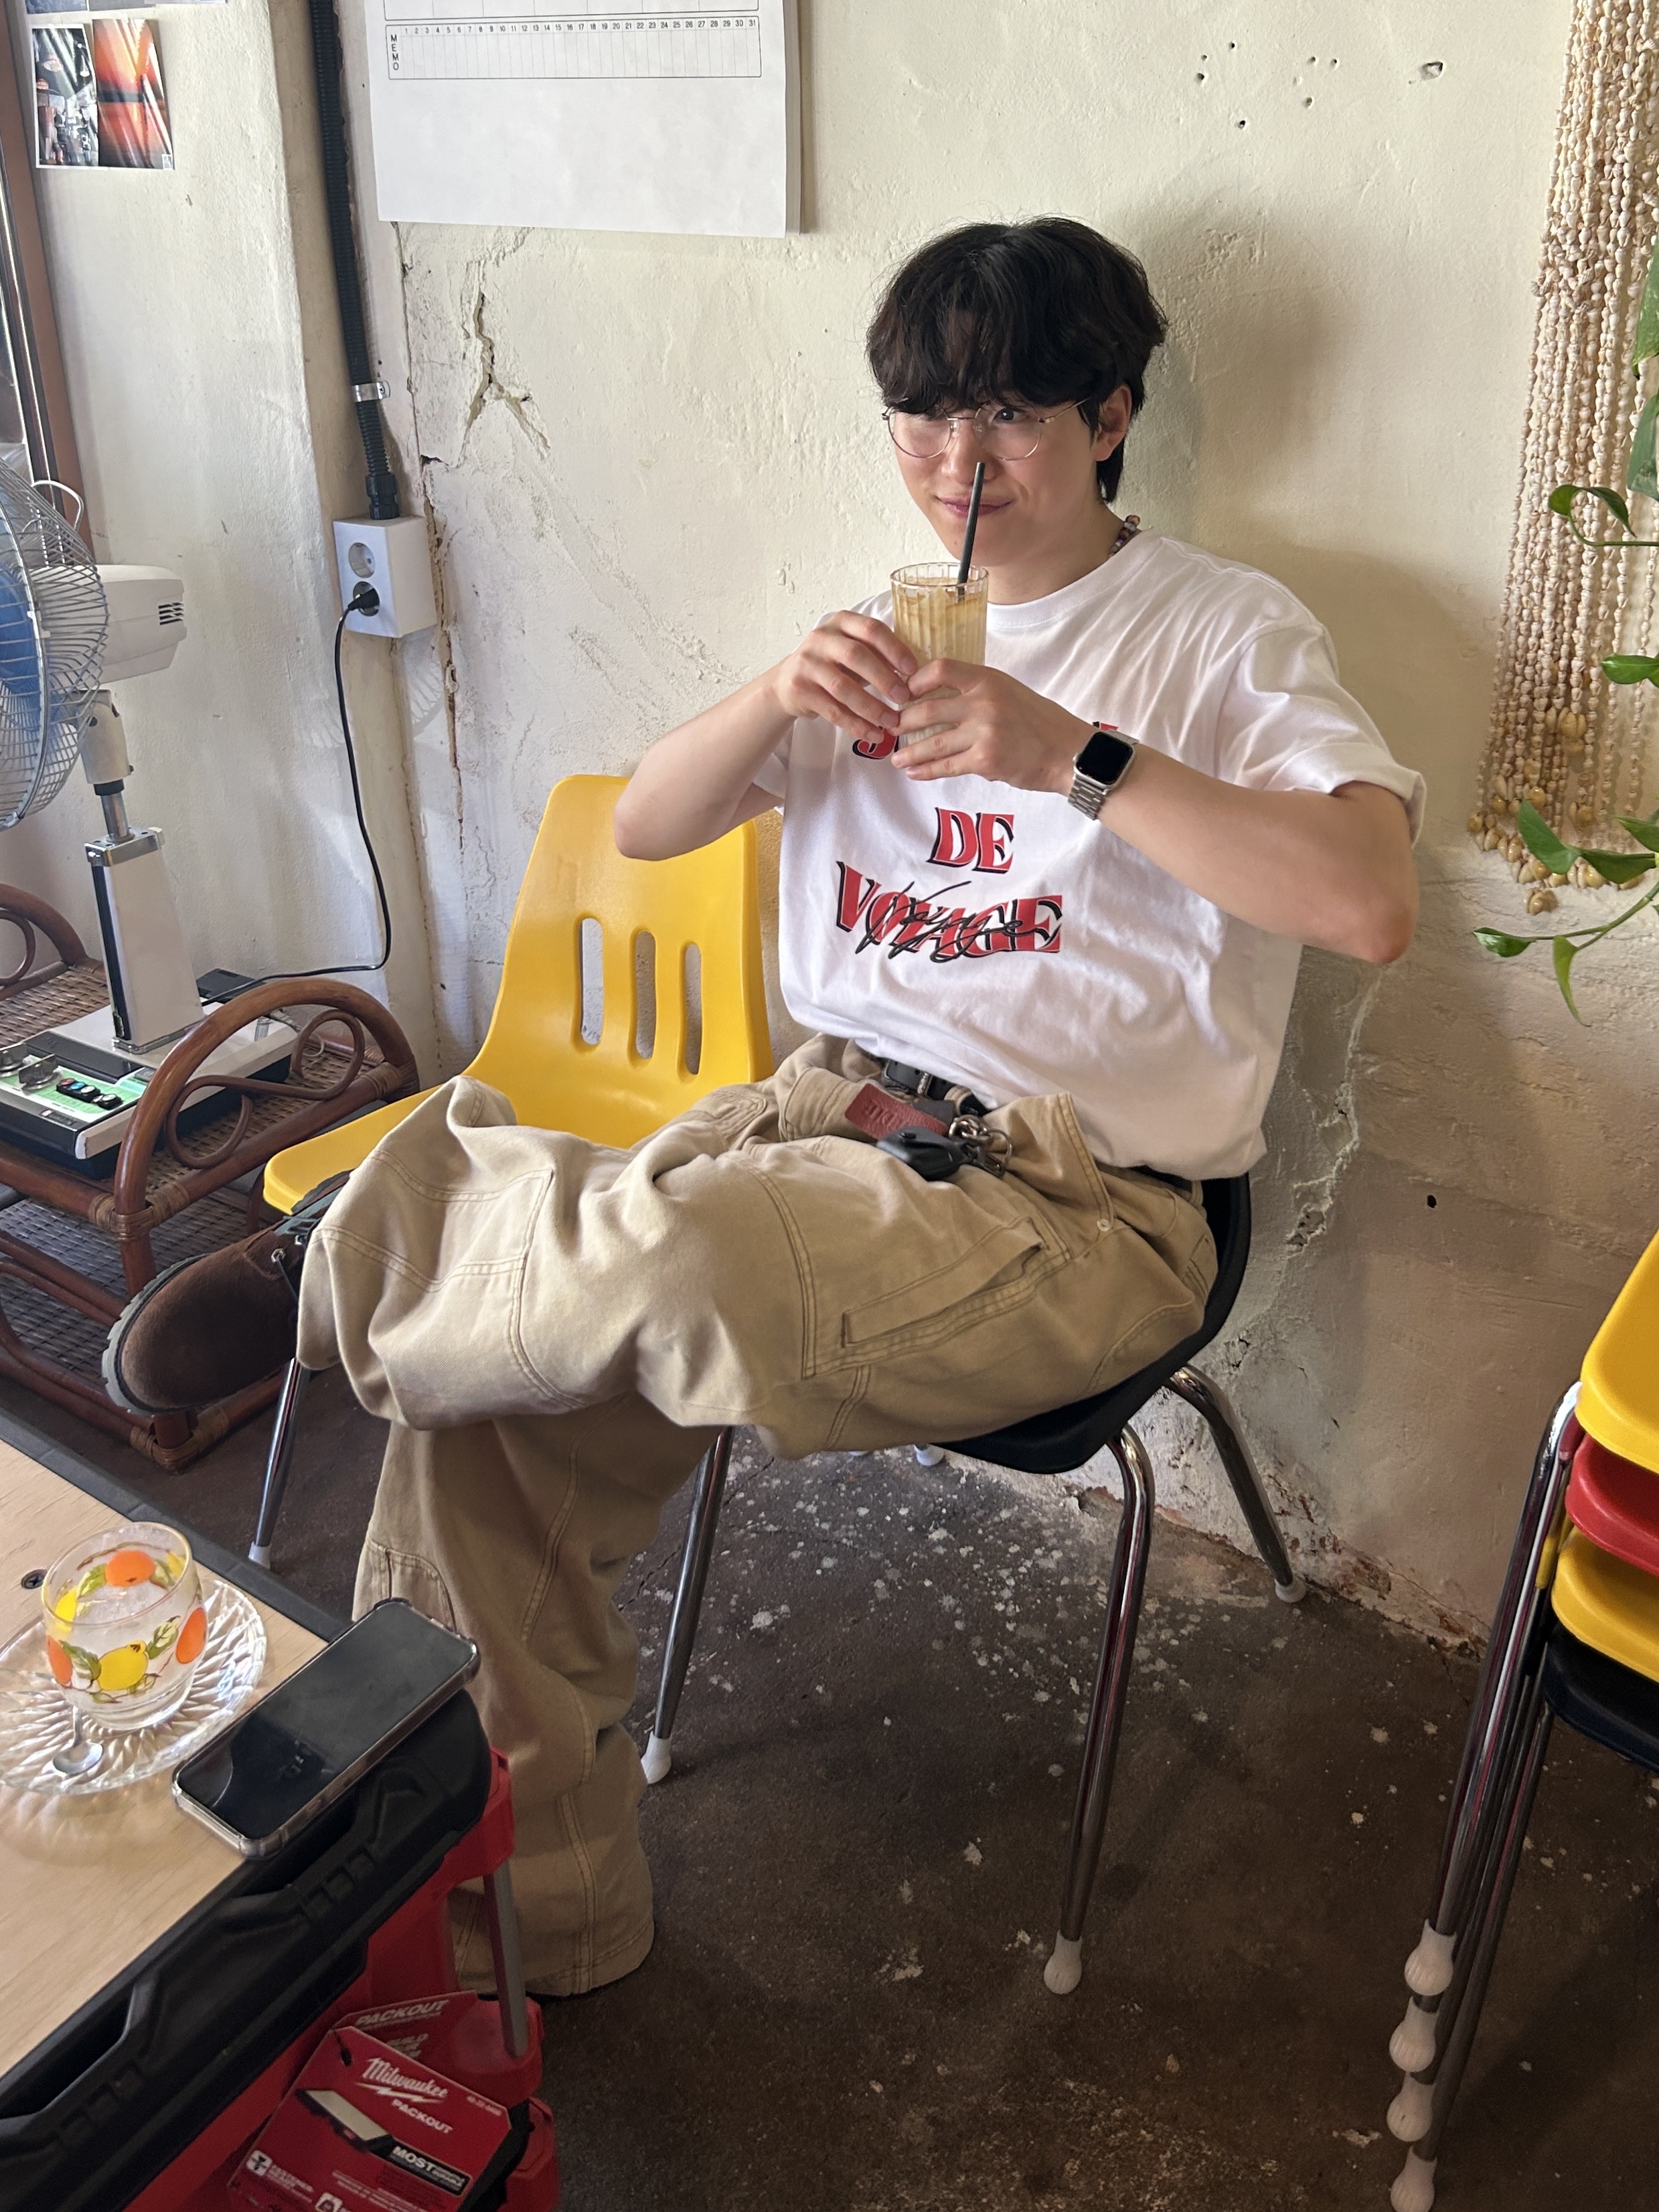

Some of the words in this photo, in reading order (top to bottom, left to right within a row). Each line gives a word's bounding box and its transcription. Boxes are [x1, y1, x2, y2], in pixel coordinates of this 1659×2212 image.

[391, 34, 399, 70] MEMO
[926, 807, 1014, 874] DE
[836, 860, 1062, 959] VOYAGE
[355, 2000, 449, 2026] PACKOUT
[362, 2057, 448, 2098] Milwaukee
[392, 2098, 453, 2134] PACKOUT
[392, 2146, 434, 2172] MOST
